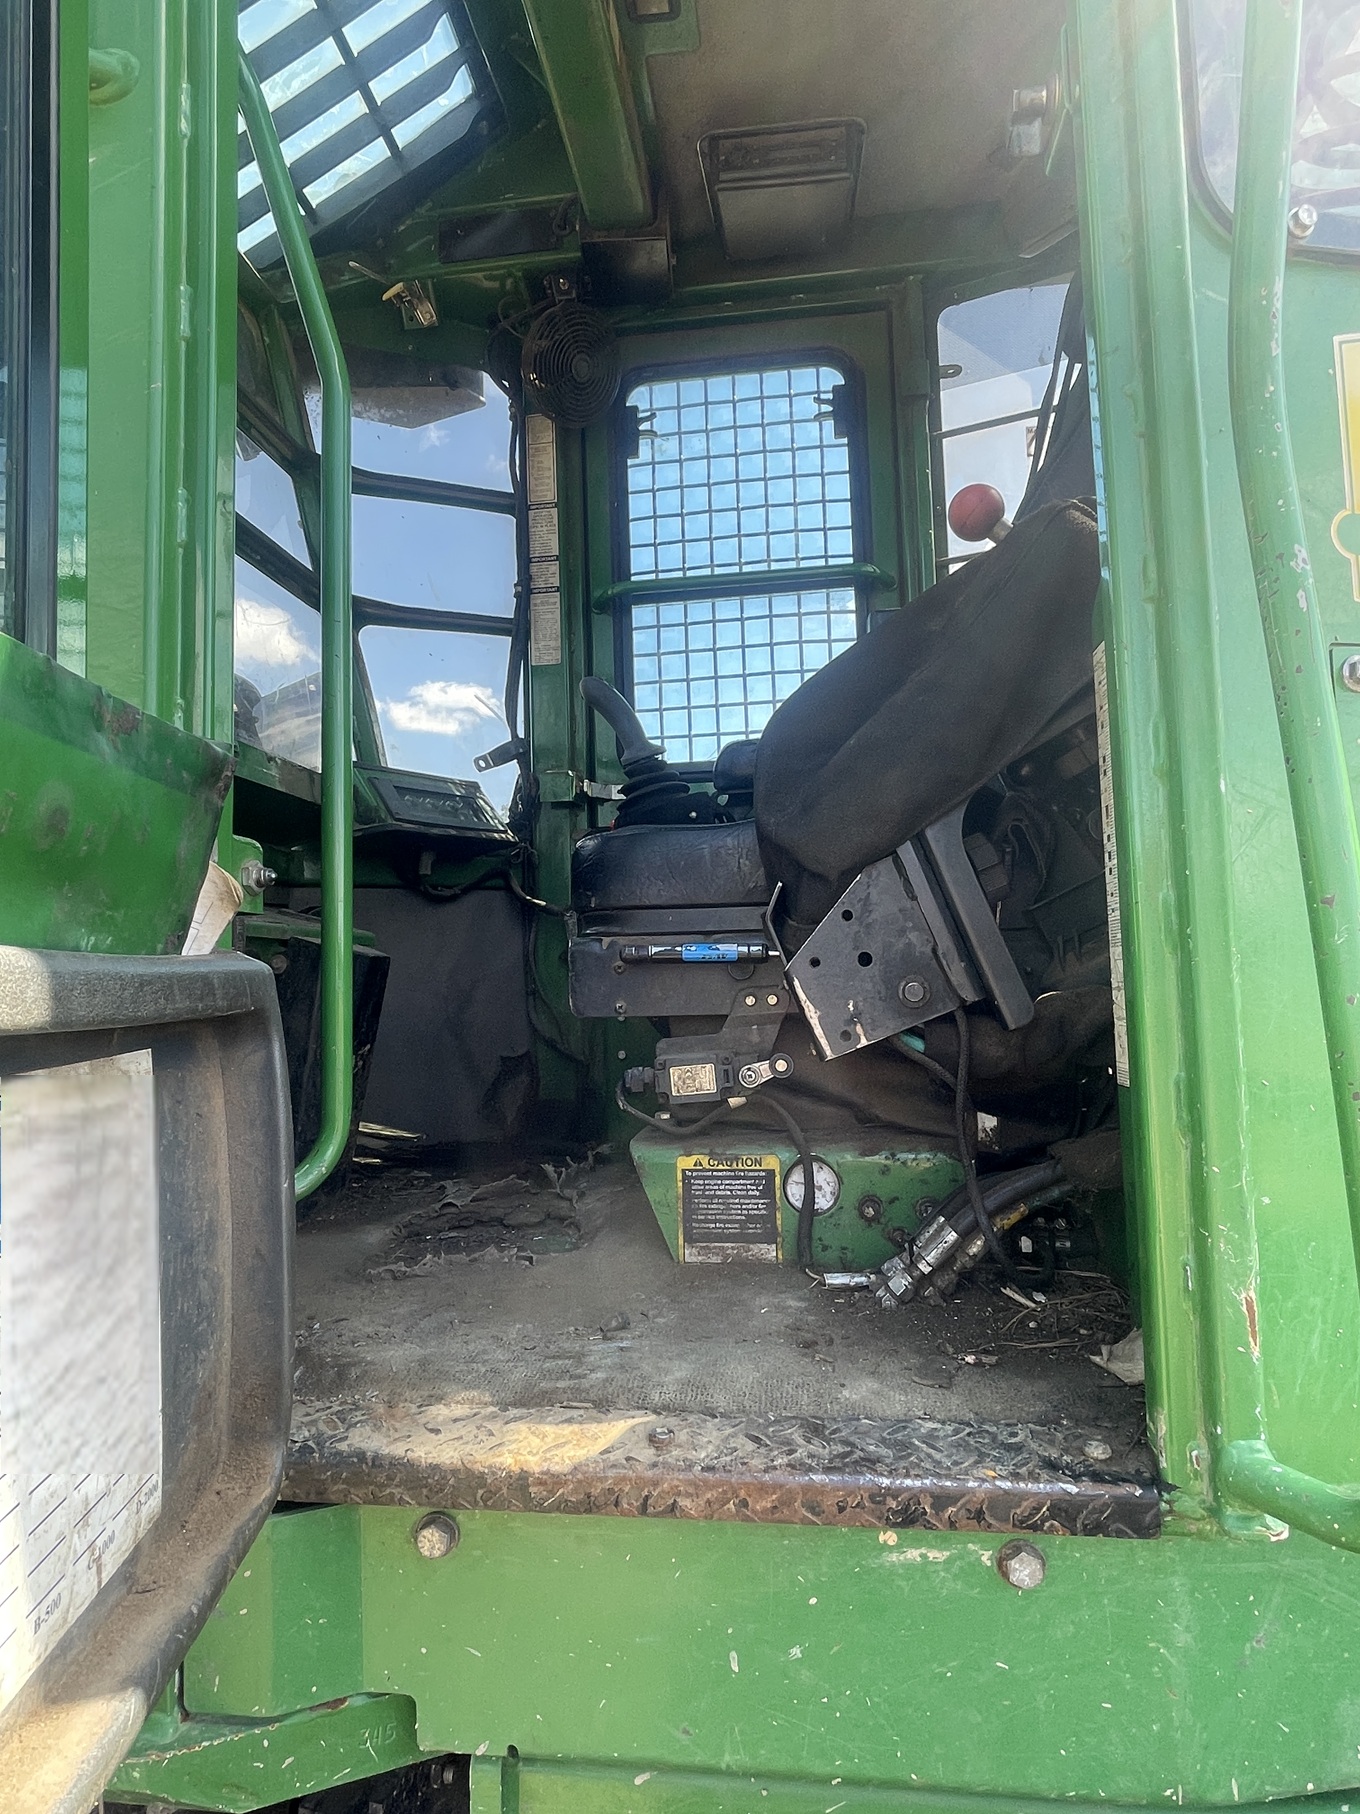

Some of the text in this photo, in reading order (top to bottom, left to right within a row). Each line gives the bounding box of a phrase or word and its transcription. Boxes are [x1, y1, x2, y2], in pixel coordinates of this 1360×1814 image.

[707, 1157, 763, 1168] CAUTION
[88, 1529, 116, 1571] C-1000
[34, 1592, 62, 1636] B-500
